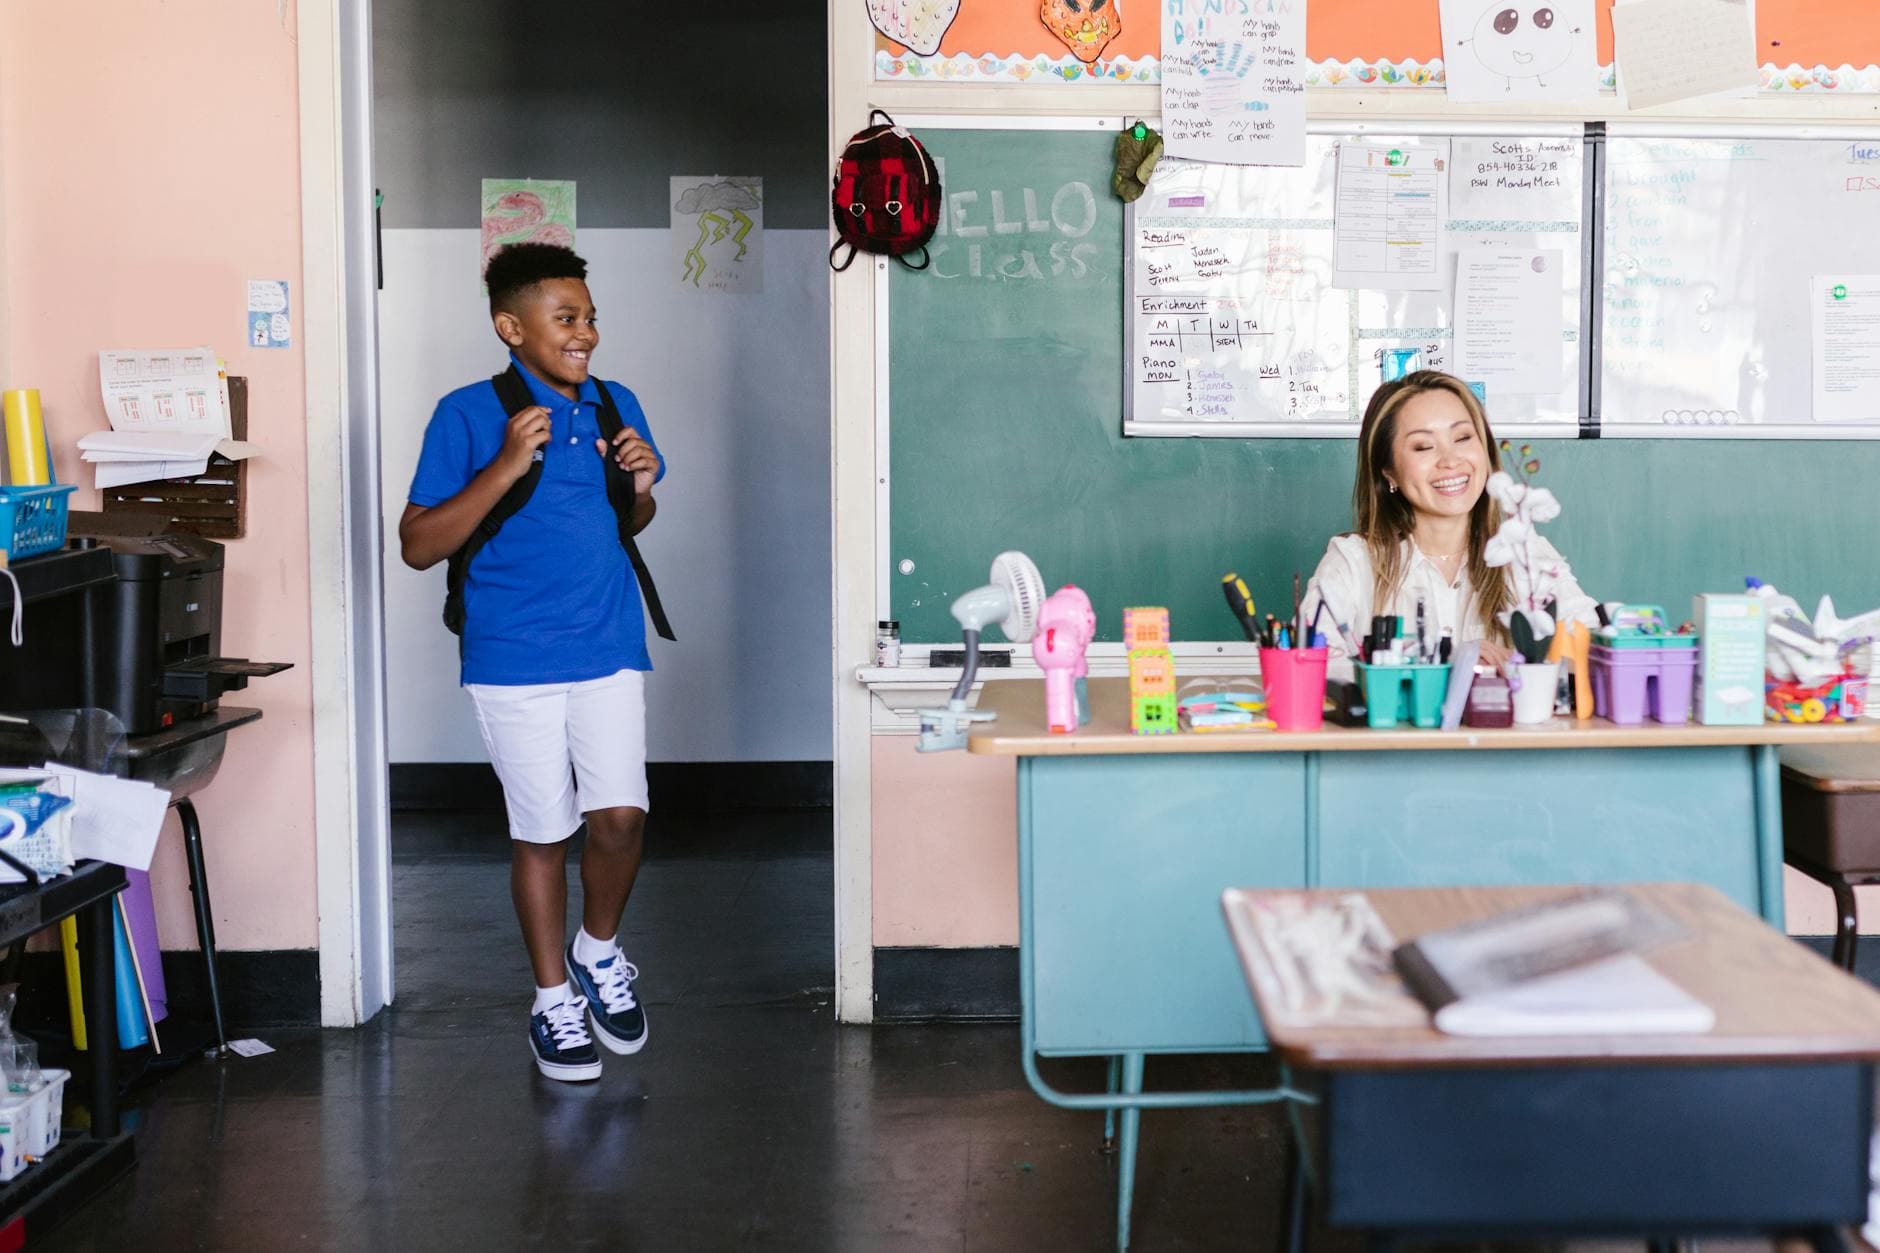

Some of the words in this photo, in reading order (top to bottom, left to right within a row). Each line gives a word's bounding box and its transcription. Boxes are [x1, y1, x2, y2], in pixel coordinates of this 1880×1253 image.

[1243, 19, 1258, 29] My
[1165, 87, 1182, 100] My
[1171, 119, 1188, 130] My
[1228, 120, 1250, 132] My
[1253, 120, 1275, 130] hands
[1142, 230, 1185, 243] Reading
[1142, 298, 1208, 312] Enrichment
[1156, 320, 1169, 329] M
[1190, 319, 1200, 332] T
[1220, 320, 1230, 329] W
[1243, 320, 1259, 331] TH
[1150, 338, 1176, 348] MMA
[1216, 338, 1236, 346] STEM
[1147, 370, 1173, 380] MON
[1259, 363, 1280, 376] Wed
